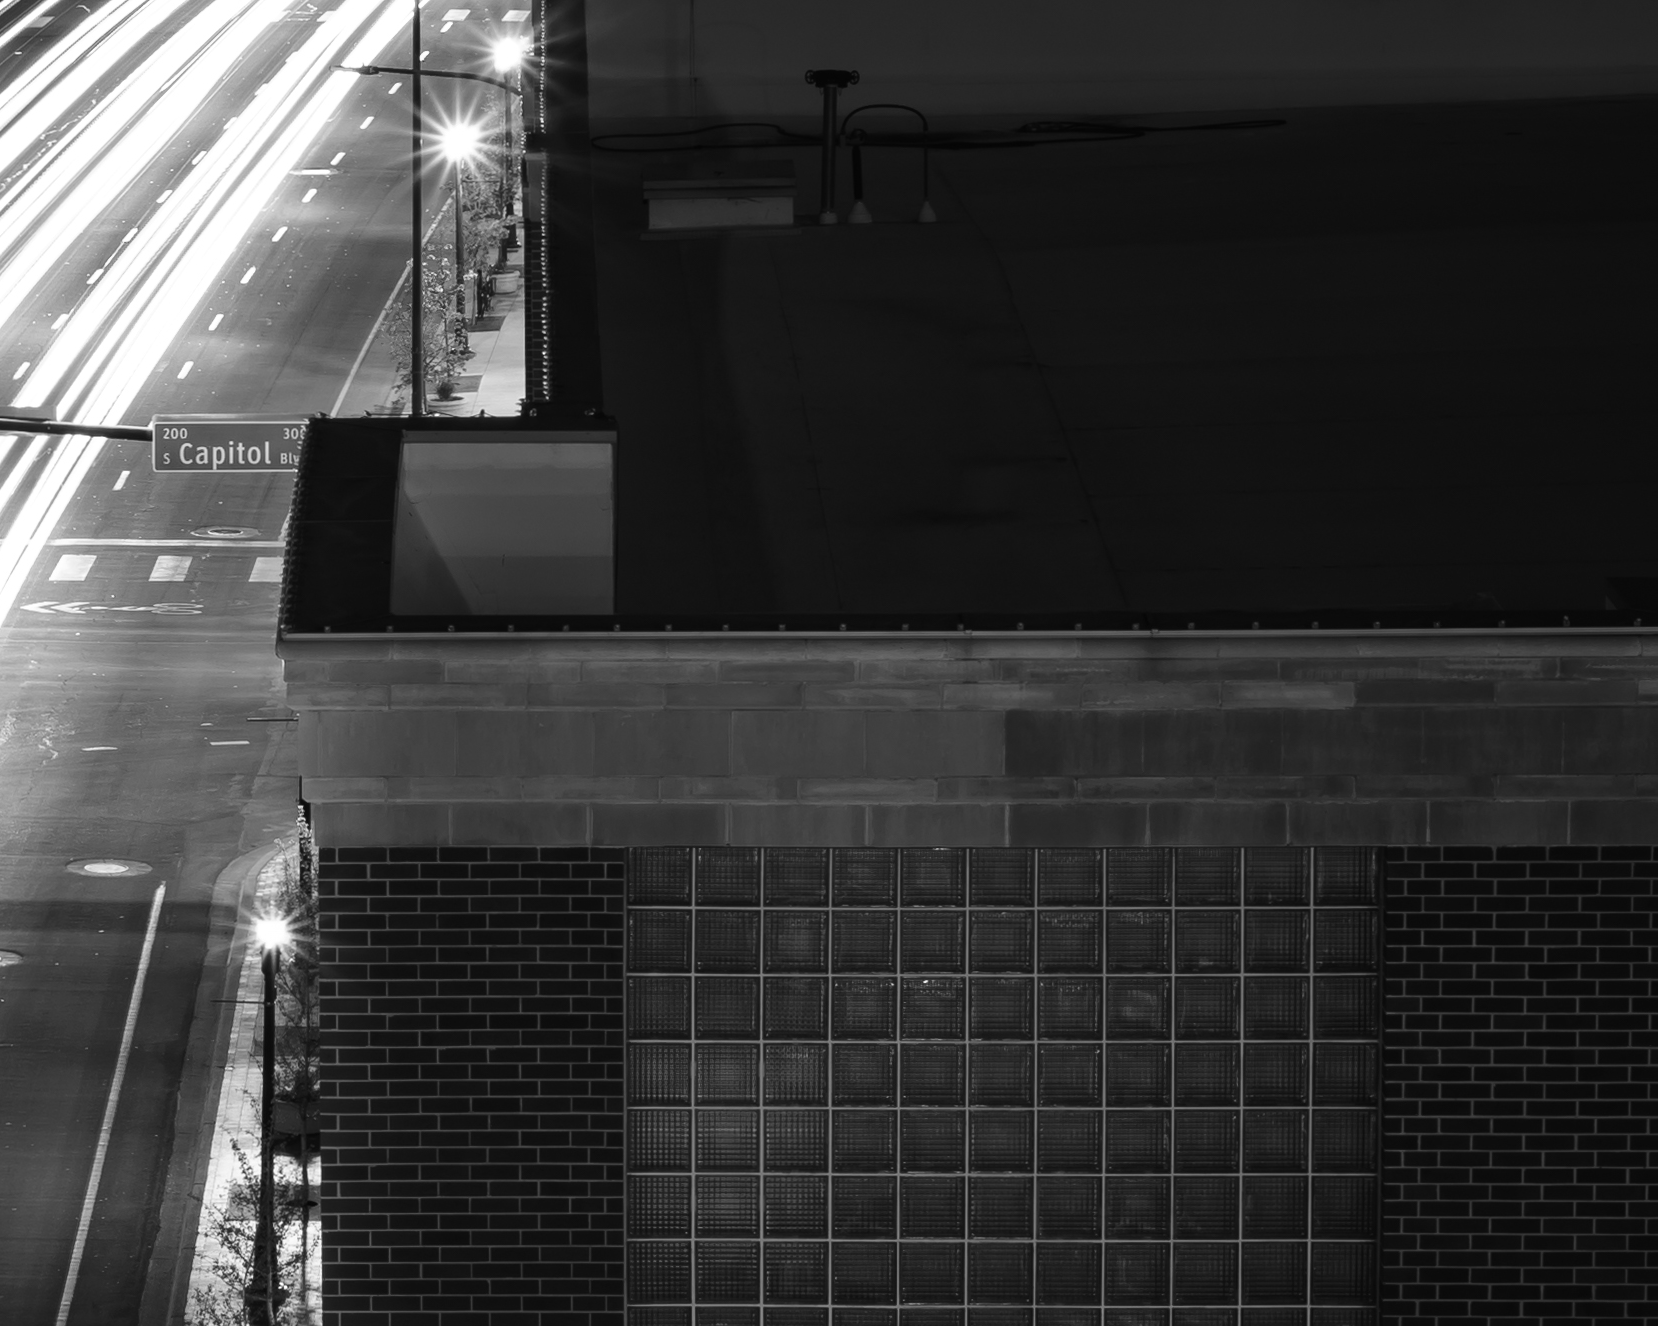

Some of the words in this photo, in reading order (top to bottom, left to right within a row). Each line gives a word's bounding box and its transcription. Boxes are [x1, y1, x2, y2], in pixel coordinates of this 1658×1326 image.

[163, 428, 188, 439] 200
[163, 453, 171, 465] S
[179, 441, 271, 470] Capitol
